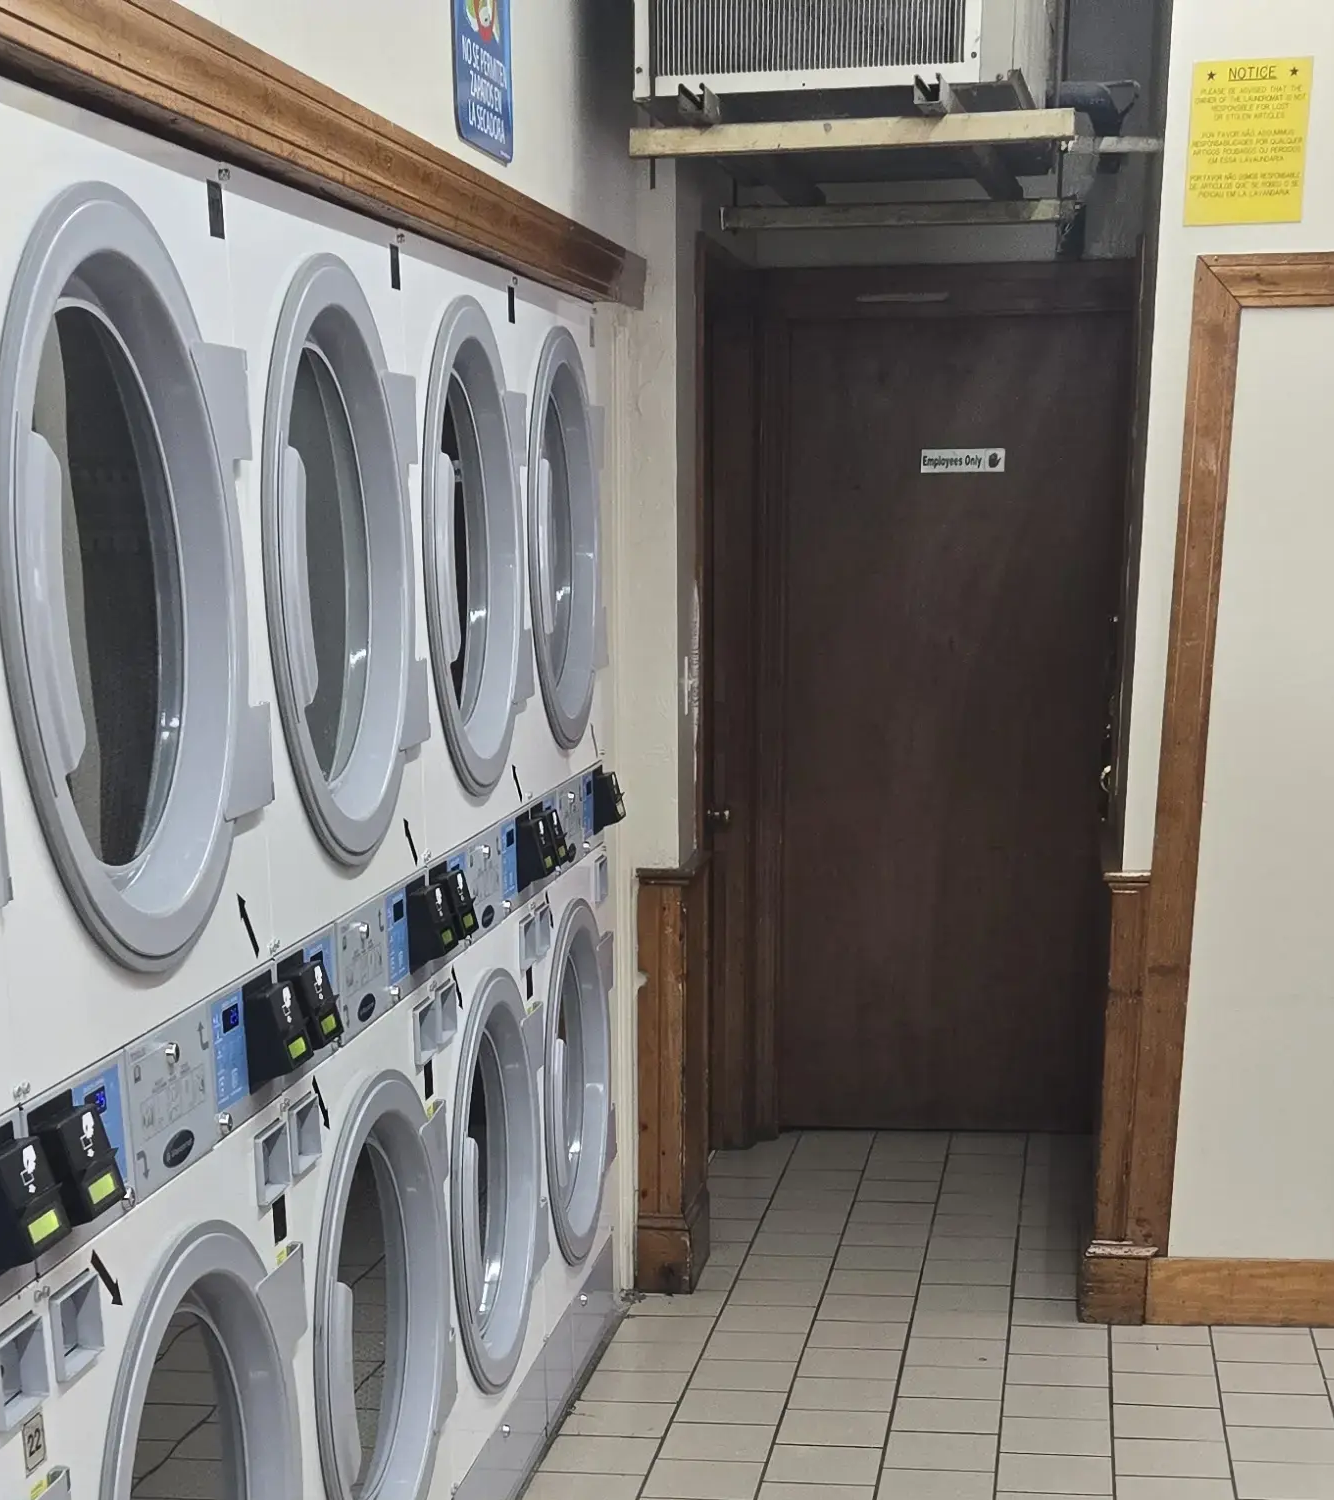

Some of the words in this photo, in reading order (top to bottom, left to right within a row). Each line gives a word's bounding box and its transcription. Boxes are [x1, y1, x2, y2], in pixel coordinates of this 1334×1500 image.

[461, 35, 472, 65] NO
[472, 42, 480, 71] SE
[480, 47, 507, 90] PERMITEN
[1228, 65, 1277, 81] NOTICE
[469, 70, 494, 109] ZAPATOS
[494, 87, 503, 114] EN
[468, 98, 477, 128] LA
[476, 104, 506, 144] SECADORA
[922, 455, 963, 468] Employees
[964, 454, 983, 468] Only
[27, 1427, 43, 1458] 22
